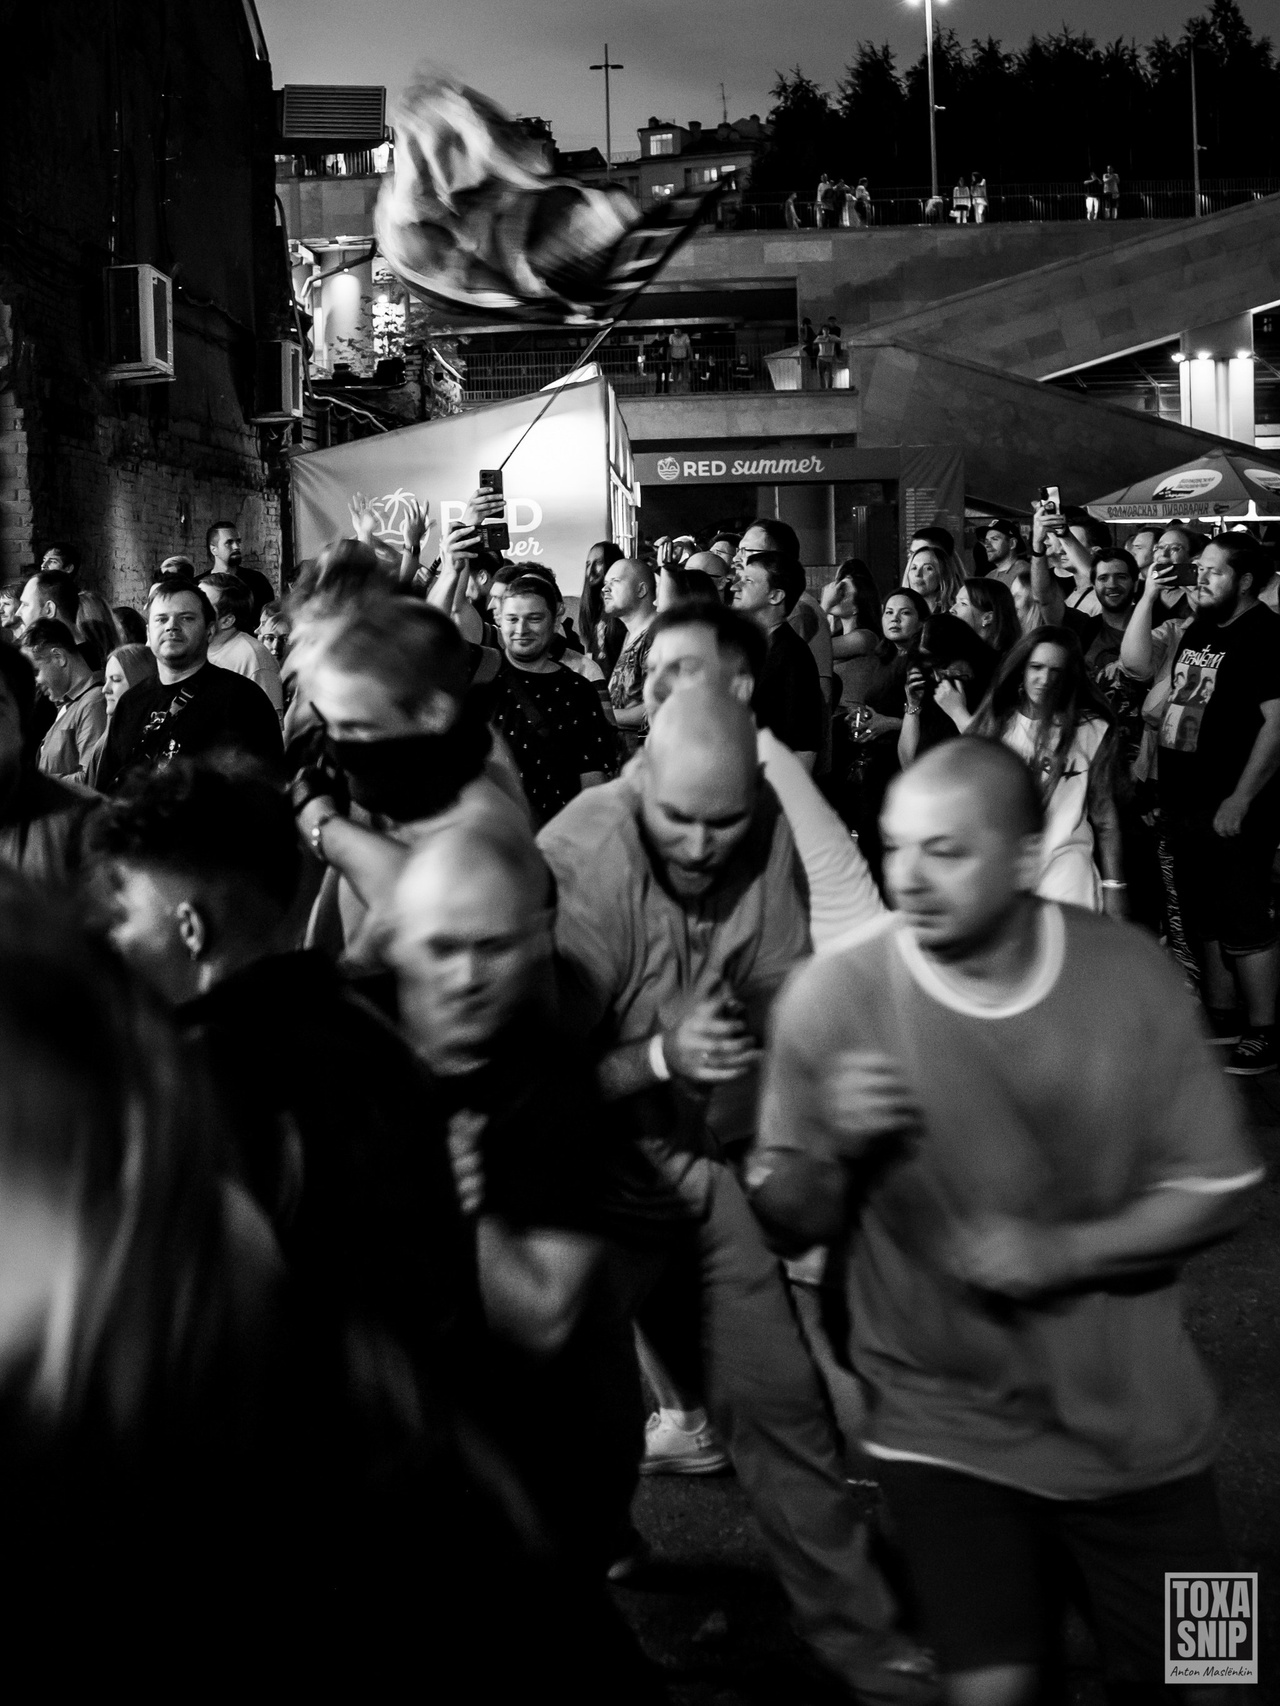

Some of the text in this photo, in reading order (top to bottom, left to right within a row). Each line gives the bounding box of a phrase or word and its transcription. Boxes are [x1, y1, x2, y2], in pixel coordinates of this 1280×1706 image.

[683, 455, 825, 477] RED summer
[440, 498, 543, 537] RD
[1162, 503, 1209, 516] ПИВОВАРНЯ
